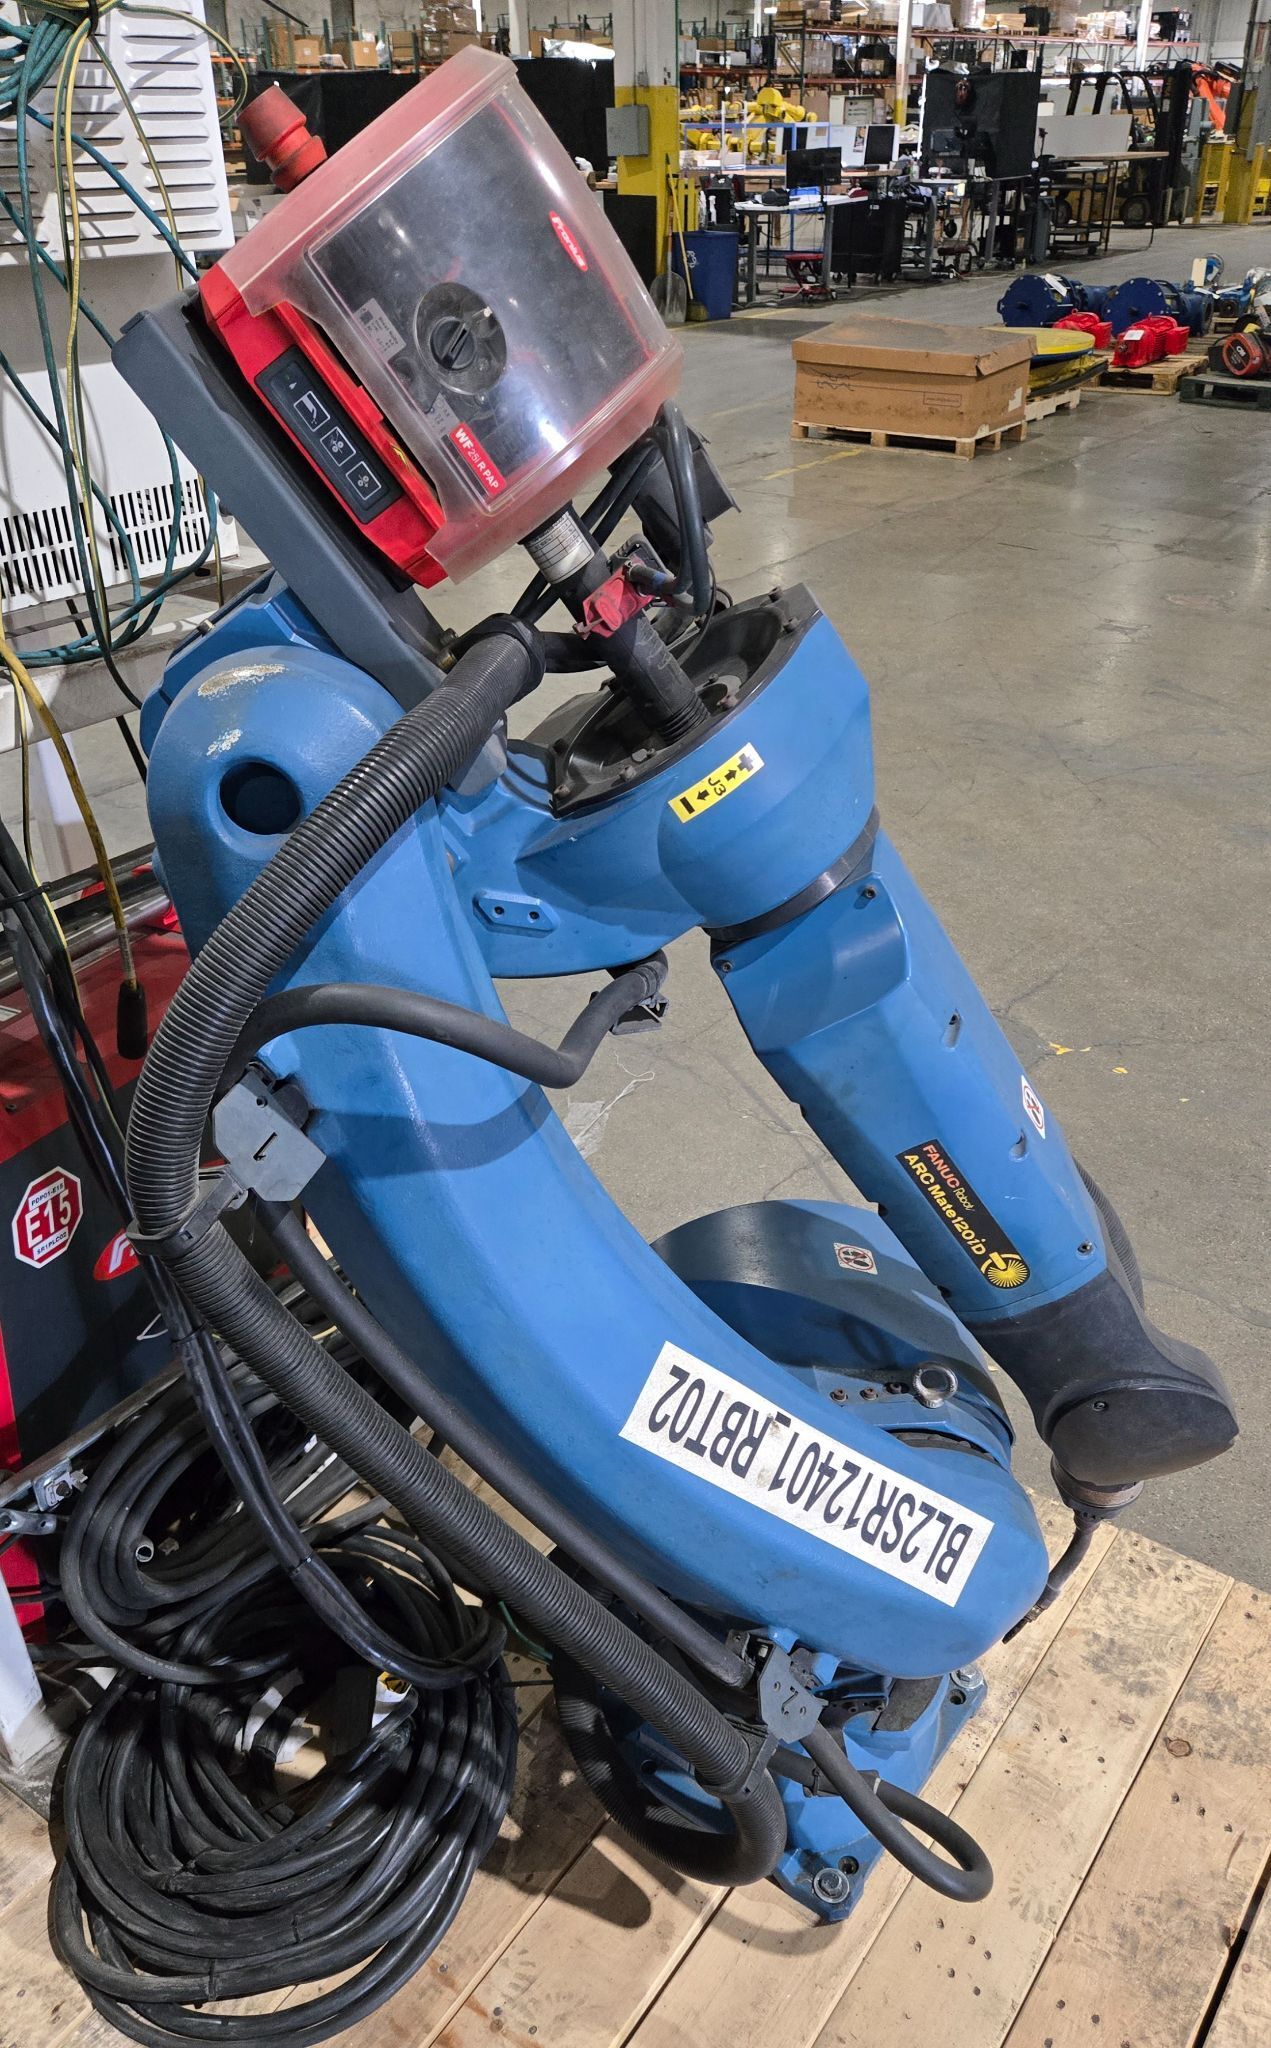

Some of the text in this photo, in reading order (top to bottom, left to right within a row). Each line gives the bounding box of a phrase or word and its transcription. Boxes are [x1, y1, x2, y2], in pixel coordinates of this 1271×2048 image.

[551, 216, 586, 267] Fronius
[455, 428, 474, 449] WF
[477, 461, 486, 471] R
[483, 469, 498, 488] PAP
[708, 777, 726, 796] J3
[904, 1154, 935, 1185] ARC
[922, 1144, 960, 1189] FANUC
[24, 1190, 72, 1249] E15
[648, 1364, 973, 1585] BL2SR12401_RBT02
